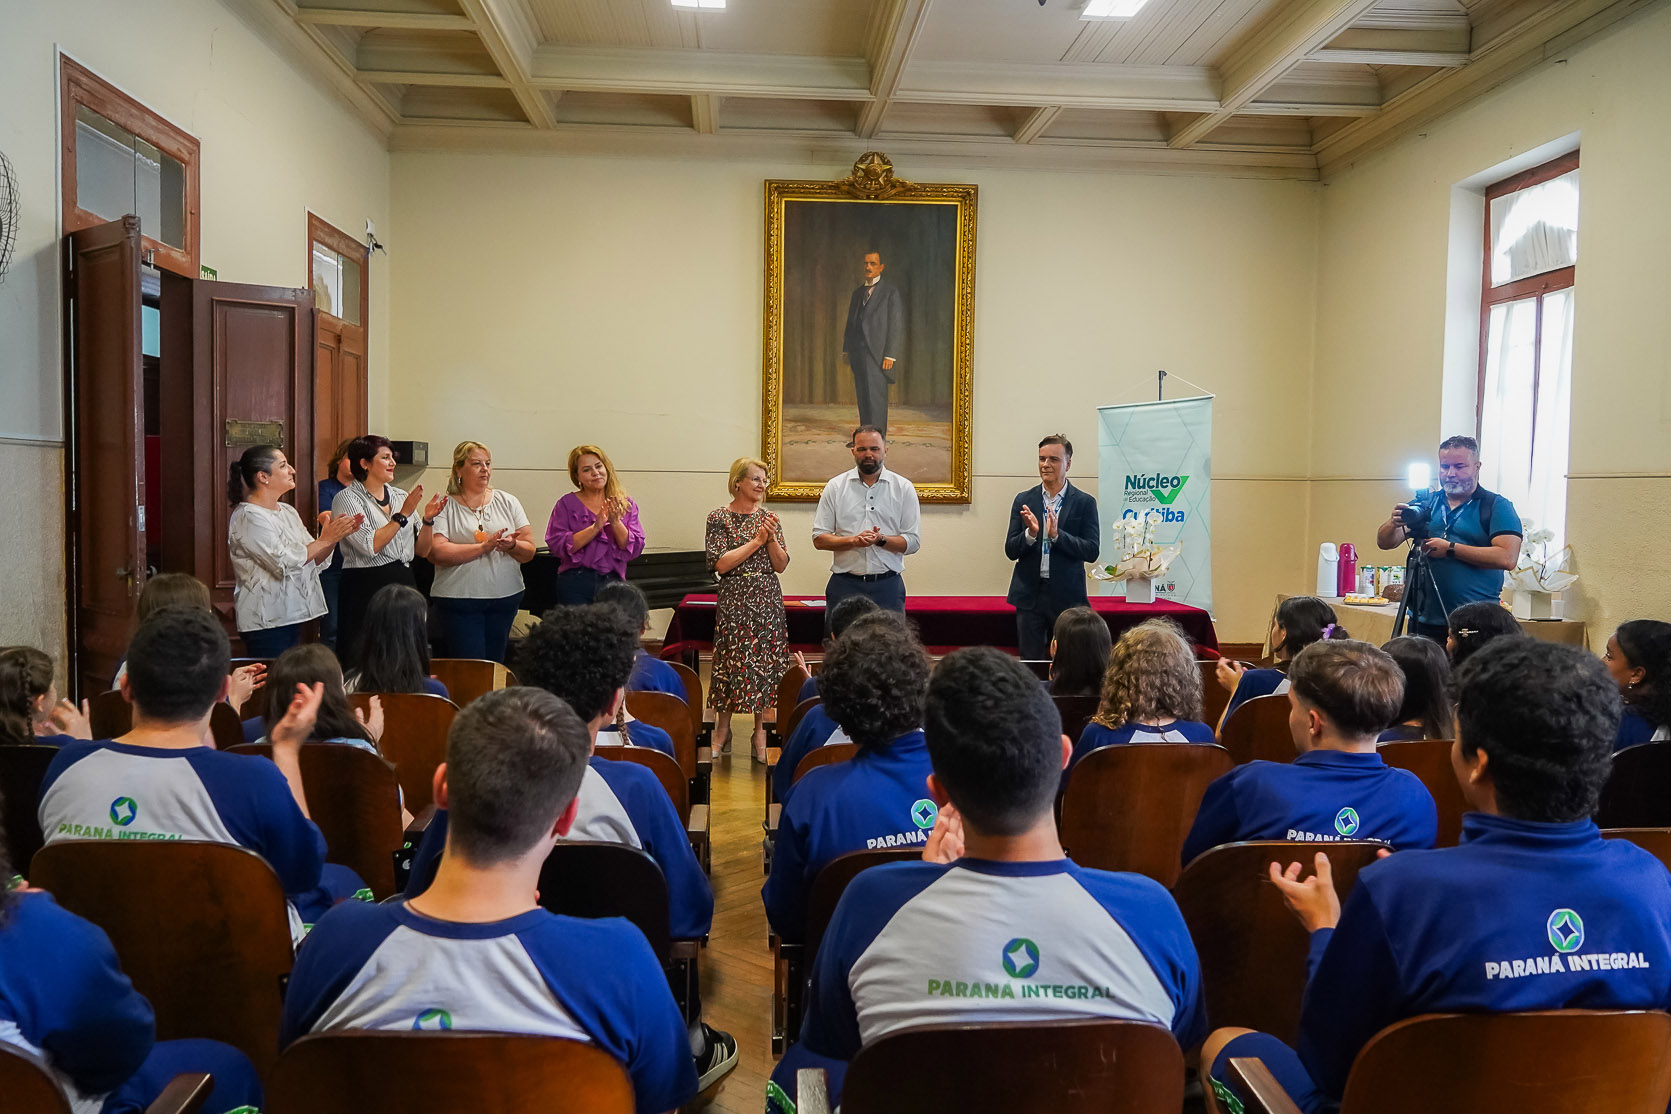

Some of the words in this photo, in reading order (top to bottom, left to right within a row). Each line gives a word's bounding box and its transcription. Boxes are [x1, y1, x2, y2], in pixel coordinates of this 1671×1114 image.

[1125, 473, 1181, 490] Núcleo
[1124, 489, 1149, 497] Regional
[1128, 495, 1157, 503] Educação
[58, 823, 114, 840] PARANÁ
[866, 828, 928, 850] PARANÁ
[1485, 952, 1566, 980] PARANÁ
[1567, 952, 1650, 972] INTEGRAL
[928, 979, 1015, 999] PARANÁ
[1021, 984, 1116, 1000] INTEGRAL
